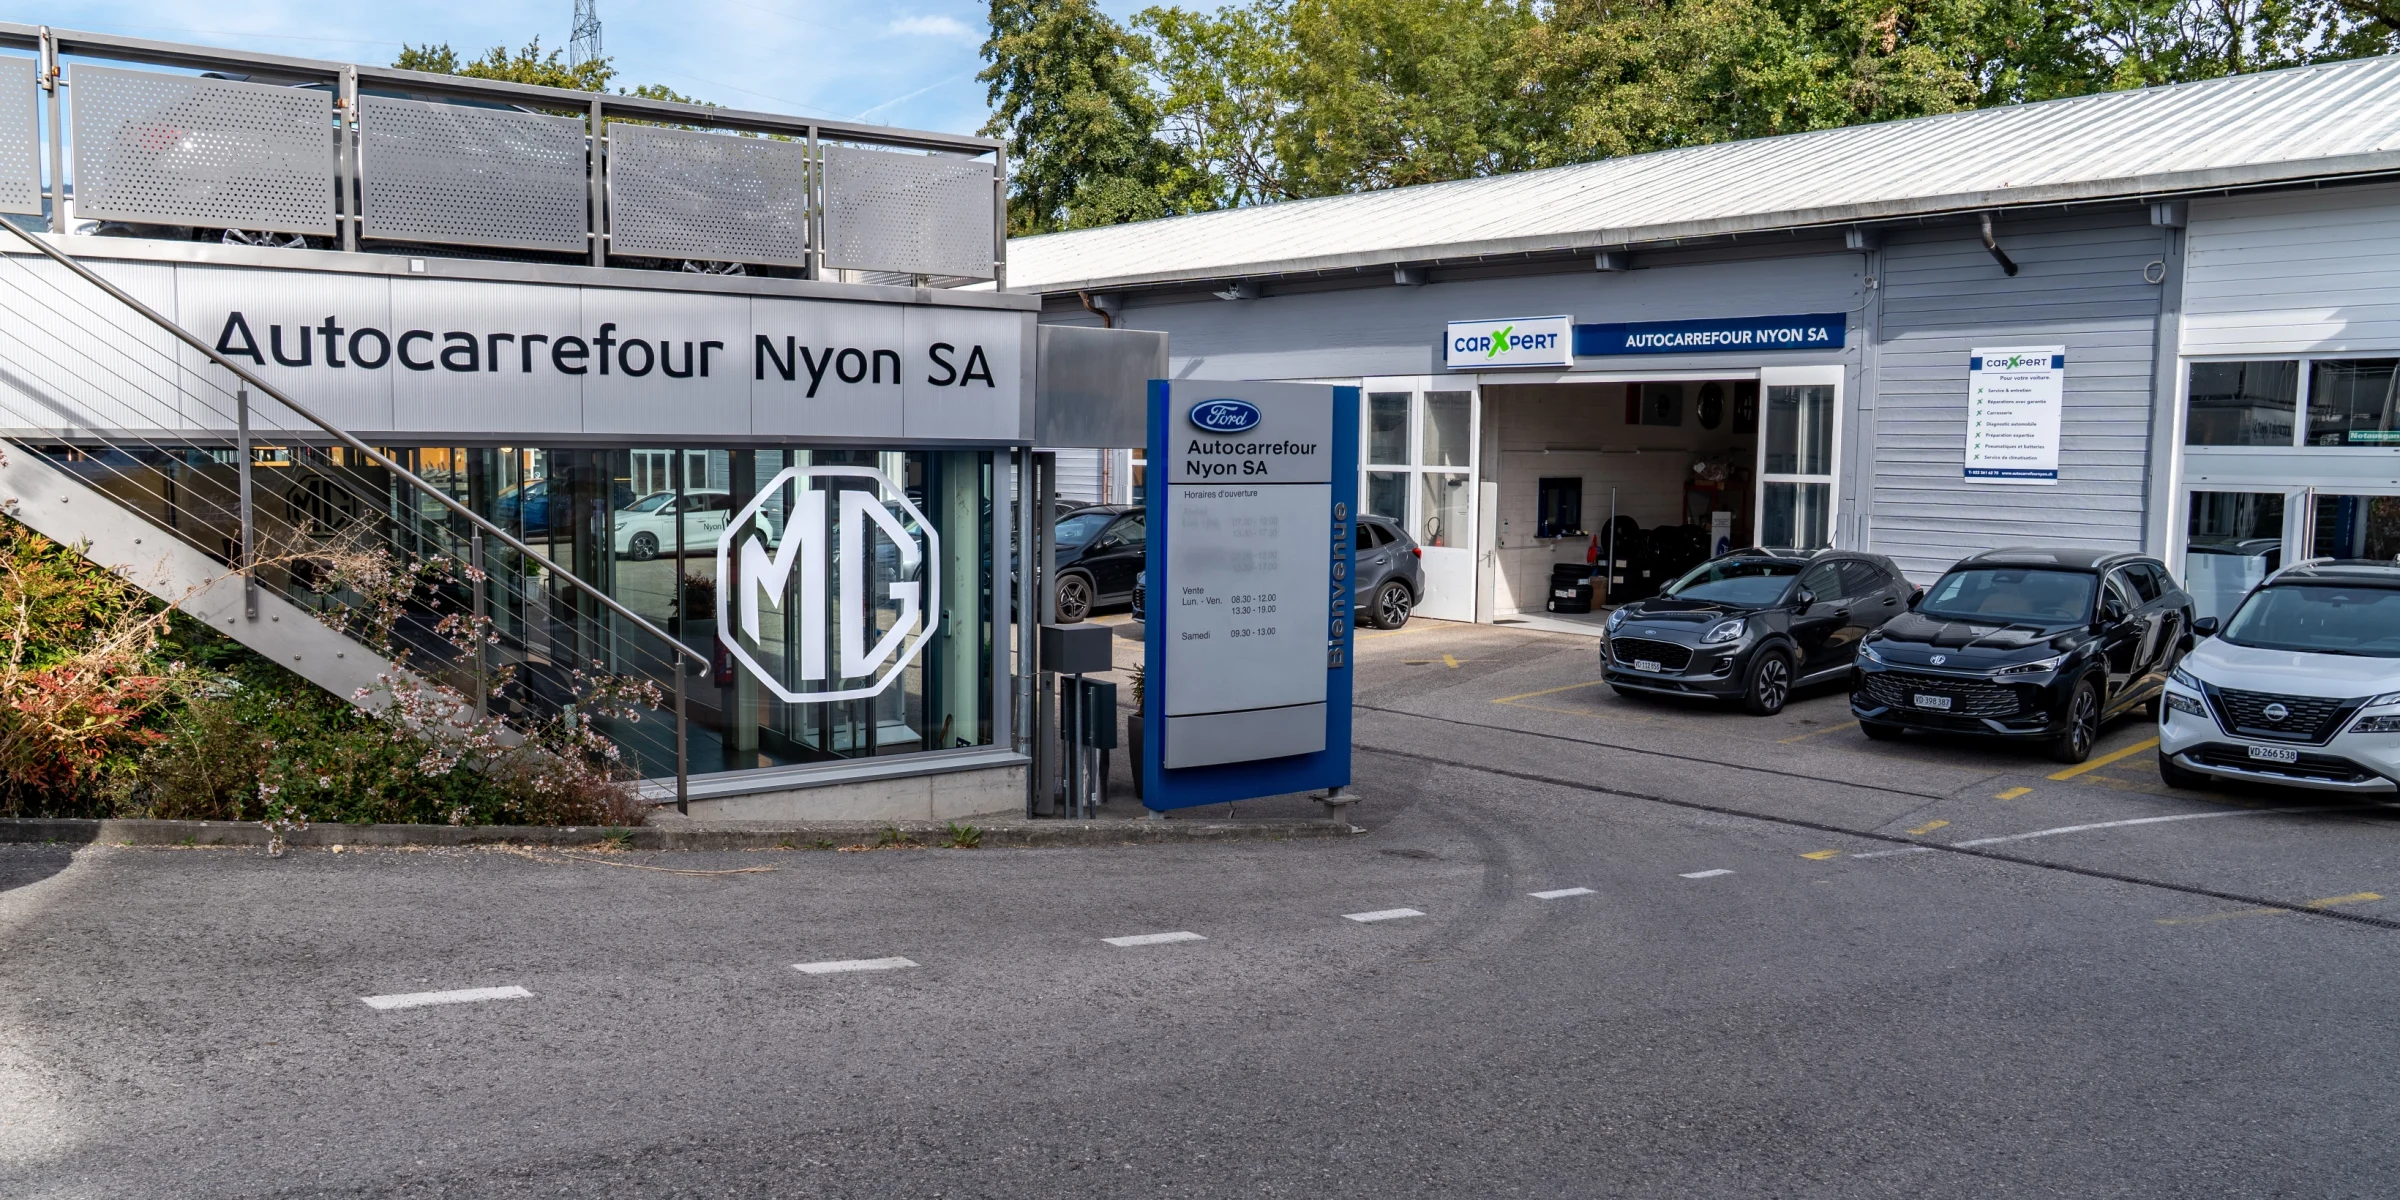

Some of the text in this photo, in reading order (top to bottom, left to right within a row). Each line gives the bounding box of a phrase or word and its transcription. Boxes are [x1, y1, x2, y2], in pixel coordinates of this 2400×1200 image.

[1626, 327, 1828, 348] AUTOCARREFOUR NYON SA
[209, 311, 996, 398] Autocarrefour Nyon SA
[1205, 404, 1249, 426] Ford
[2350, 432, 2400, 440] Notausgan
[1187, 439, 1317, 455] Autocarrefour
[1186, 460, 1268, 478] Nyon SA
[1184, 489, 1258, 499] Horaires d'ouverture
[703, 523, 722, 532] Nyon
[741, 490, 920, 681] MG
[1182, 587, 1205, 595] Vente
[1327, 501, 1348, 668] Bienvenue
[1182, 598, 1199, 606] Lun.
[1206, 597, 1223, 605] Ven.
[1231, 595, 1251, 603] 08.30
[1258, 594, 1277, 602] 12.00
[1231, 607, 1251, 615] 13.30
[1257, 605, 1277, 613] 19.00
[1181, 631, 1211, 640] Samedi
[1230, 629, 1251, 638] 09.30
[1257, 627, 1276, 636] 13.00
